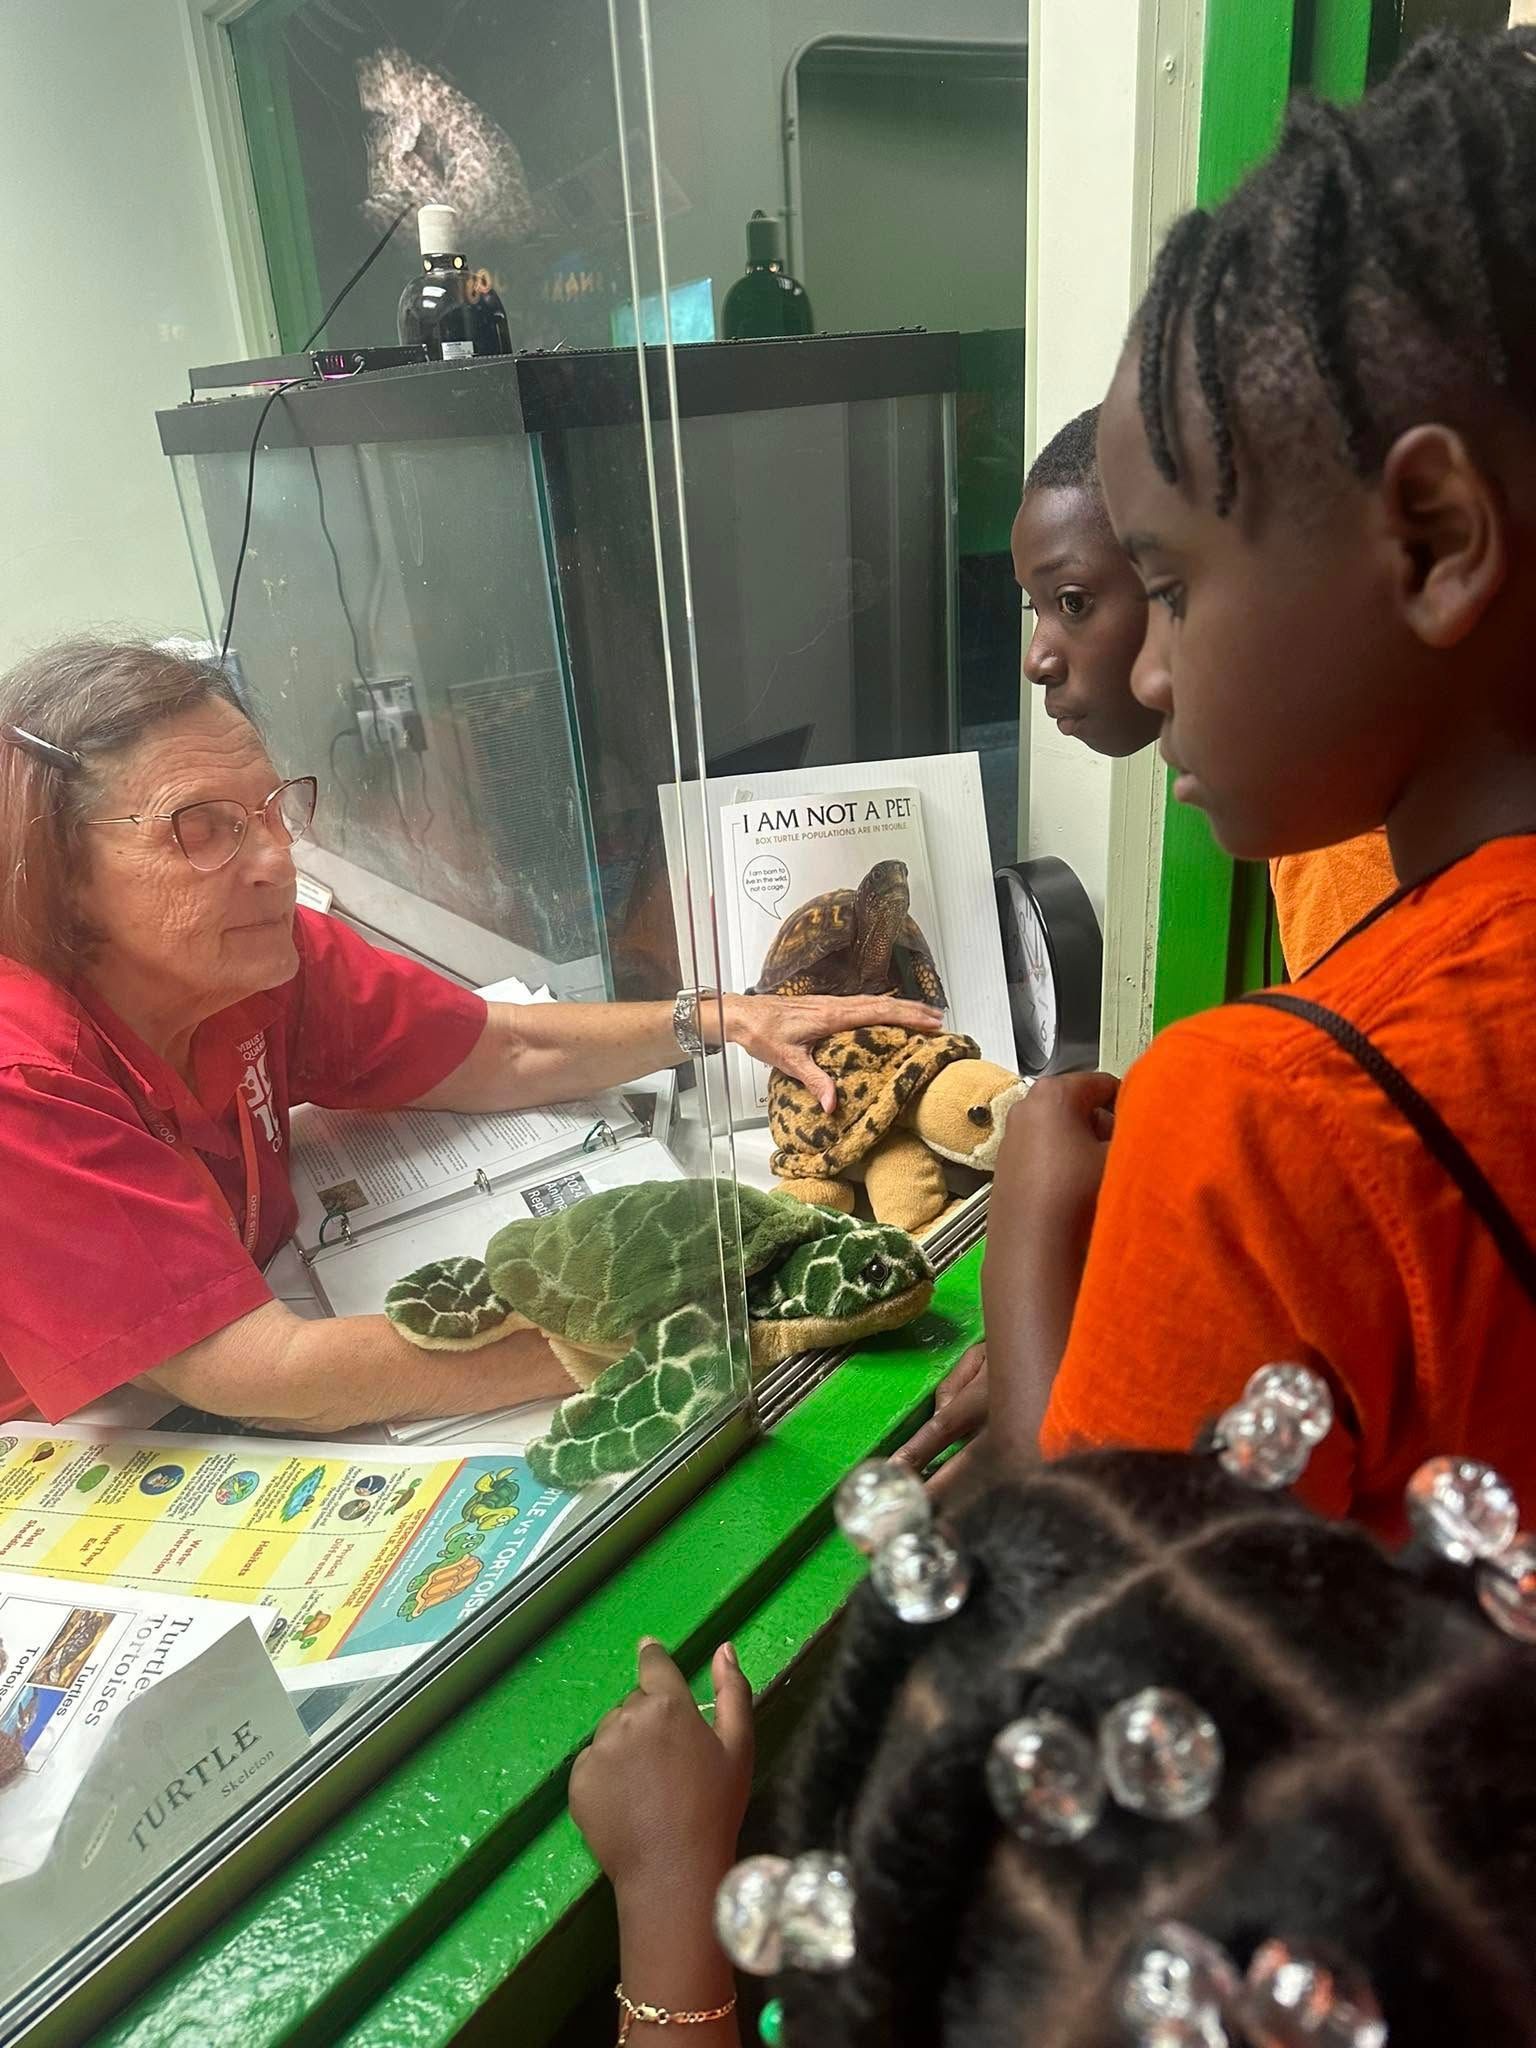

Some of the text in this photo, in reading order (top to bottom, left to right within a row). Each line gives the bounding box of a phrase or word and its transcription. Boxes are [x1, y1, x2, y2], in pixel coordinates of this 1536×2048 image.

[743, 798, 911, 833] I AM NOT A PET
[755, 837, 772, 845] BOX
[774, 834, 799, 843] TURTLE
[801, 828, 856, 840] POPULATIONS
[857, 826, 871, 834] ARE
[873, 825, 881, 833] IN
[545, 1182, 568, 1211] Anima
[563, 1175, 586, 1199] 2024
[526, 1487, 563, 1517] RTLE
[20, 1527, 46, 1548] Shell
[79, 1537, 98, 1552] Eat
[80, 1523, 125, 1567] What They
[385, 1512, 414, 1546] TURTLE
[152, 1528, 195, 1575] Interaction
[176, 1539, 202, 1566] Water
[238, 1540, 270, 1577] Habitats
[304, 1538, 344, 1585] Differences
[324, 1543, 355, 1578] Physical
[457, 1538, 527, 1620] TORTOISE
[0, 1646, 40, 1702] Tortois
[84, 1614, 168, 1726] Tortoises
[56, 1663, 99, 1717] Turtles
[128, 1720, 262, 1851] TURTLE
[221, 1750, 275, 1798] Skeleton
